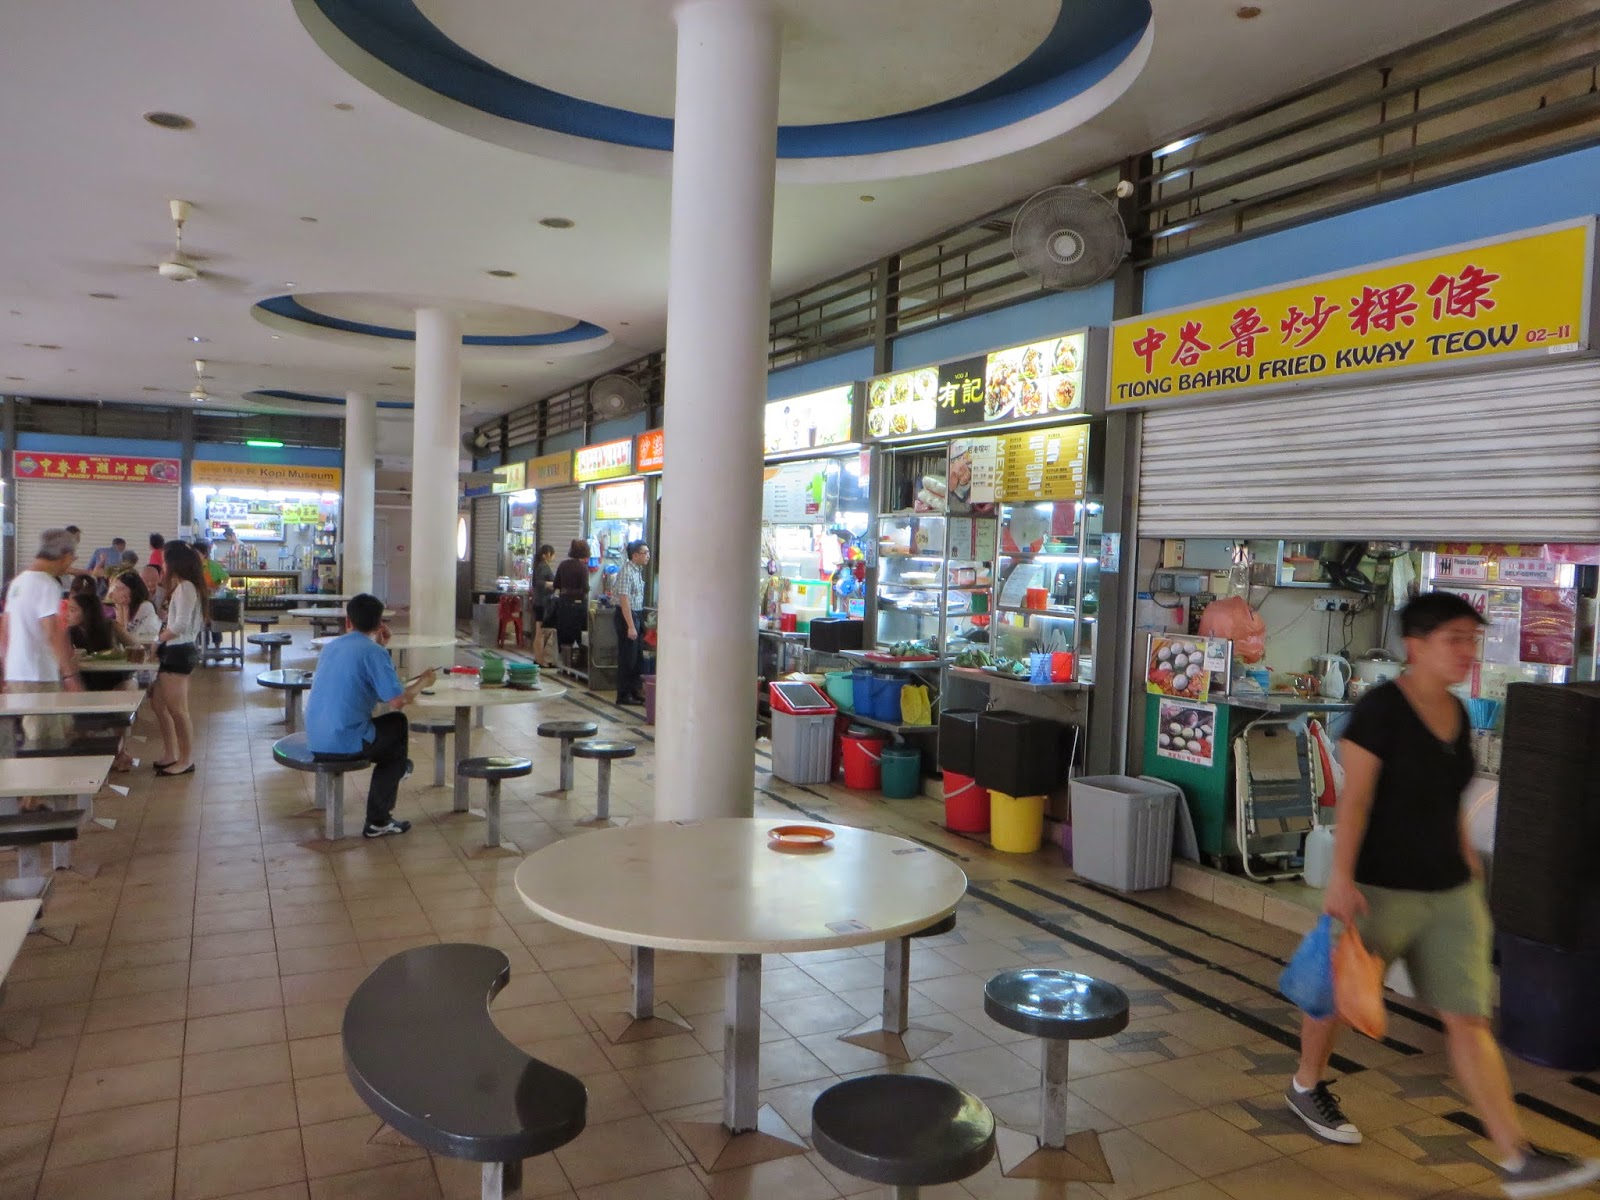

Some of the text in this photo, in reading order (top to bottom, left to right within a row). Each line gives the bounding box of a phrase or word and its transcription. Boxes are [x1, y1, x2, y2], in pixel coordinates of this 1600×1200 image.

[1132, 264, 1501, 374] 中峇魯炒粿條
[1117, 323, 1570, 399] TIONG BAHRU FRIED KWAY TEOW 02-11
[937, 378, 984, 409] 有記
[260, 468, 286, 478] Kopi
[288, 470, 334, 480] Museum
[995, 439, 1006, 499] MENU
